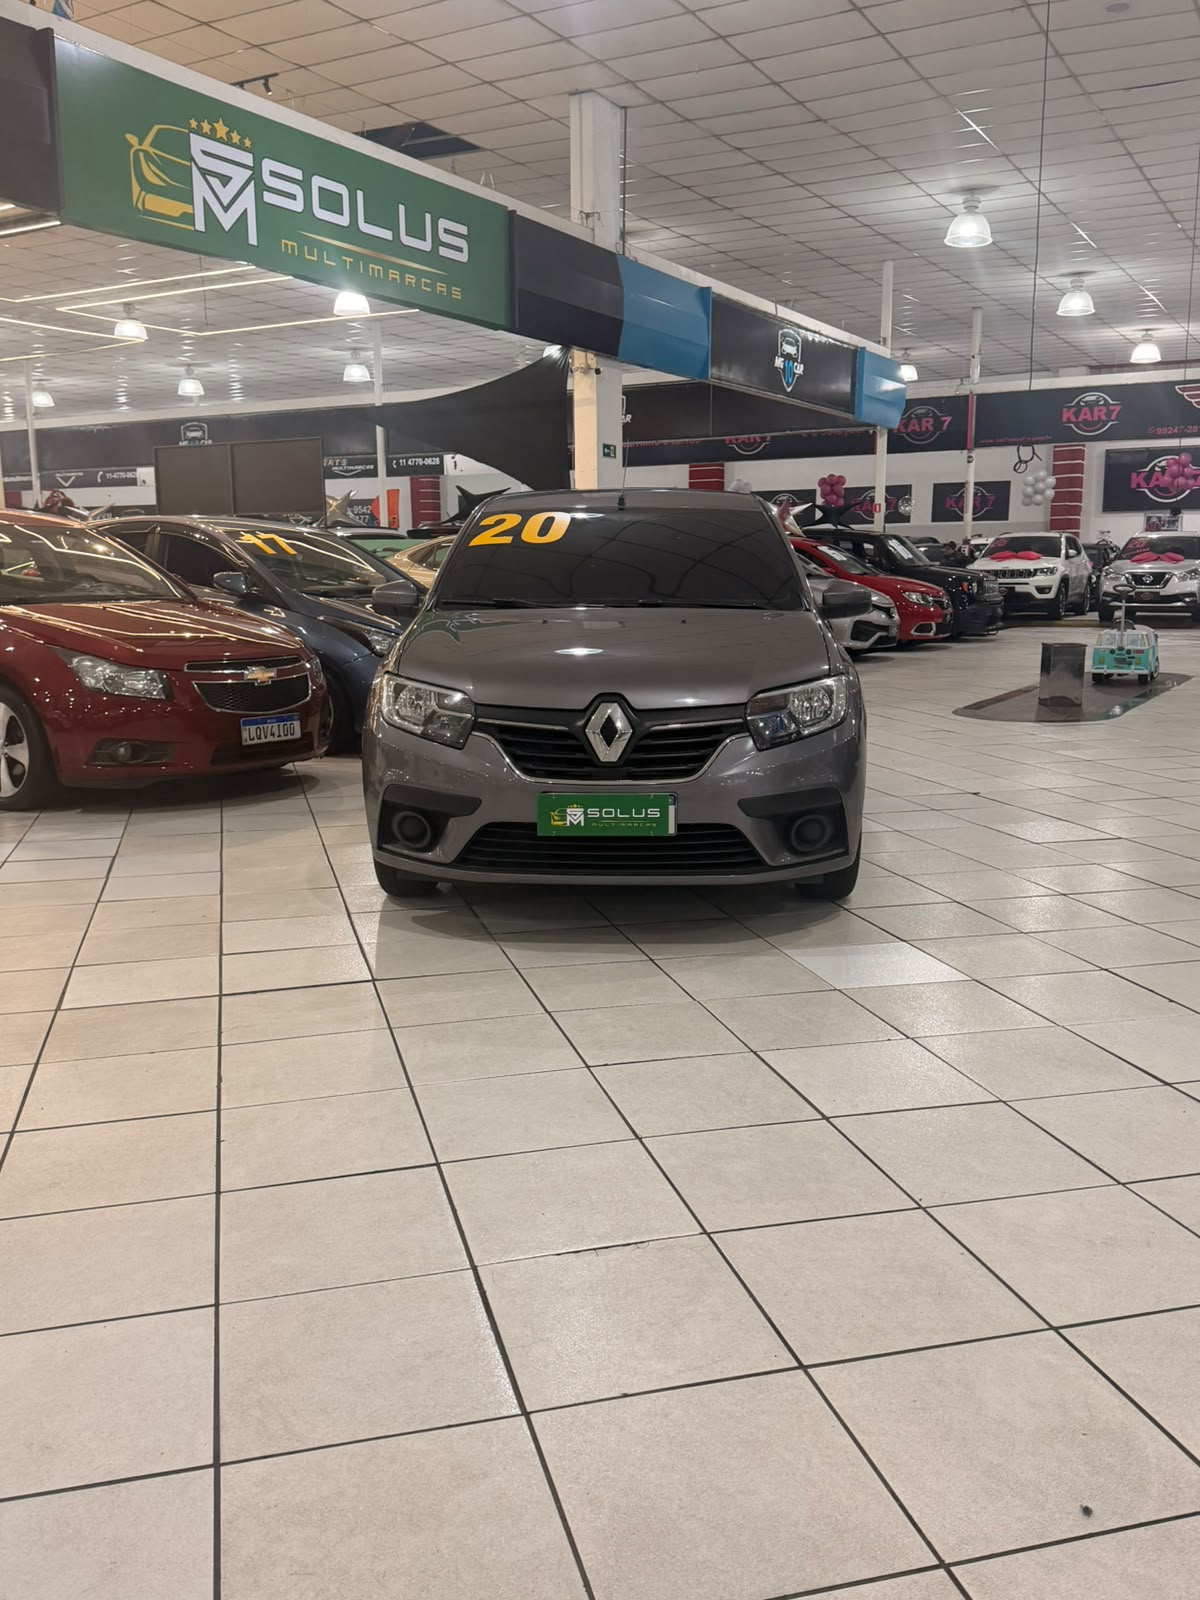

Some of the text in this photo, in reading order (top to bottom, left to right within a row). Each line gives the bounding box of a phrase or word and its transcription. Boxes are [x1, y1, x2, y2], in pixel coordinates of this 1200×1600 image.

[261, 157, 469, 263] SOLUS
[280, 239, 462, 300] MULTIMARCAS
[468, 511, 571, 547] 20
[587, 808, 660, 818] SOLUS
